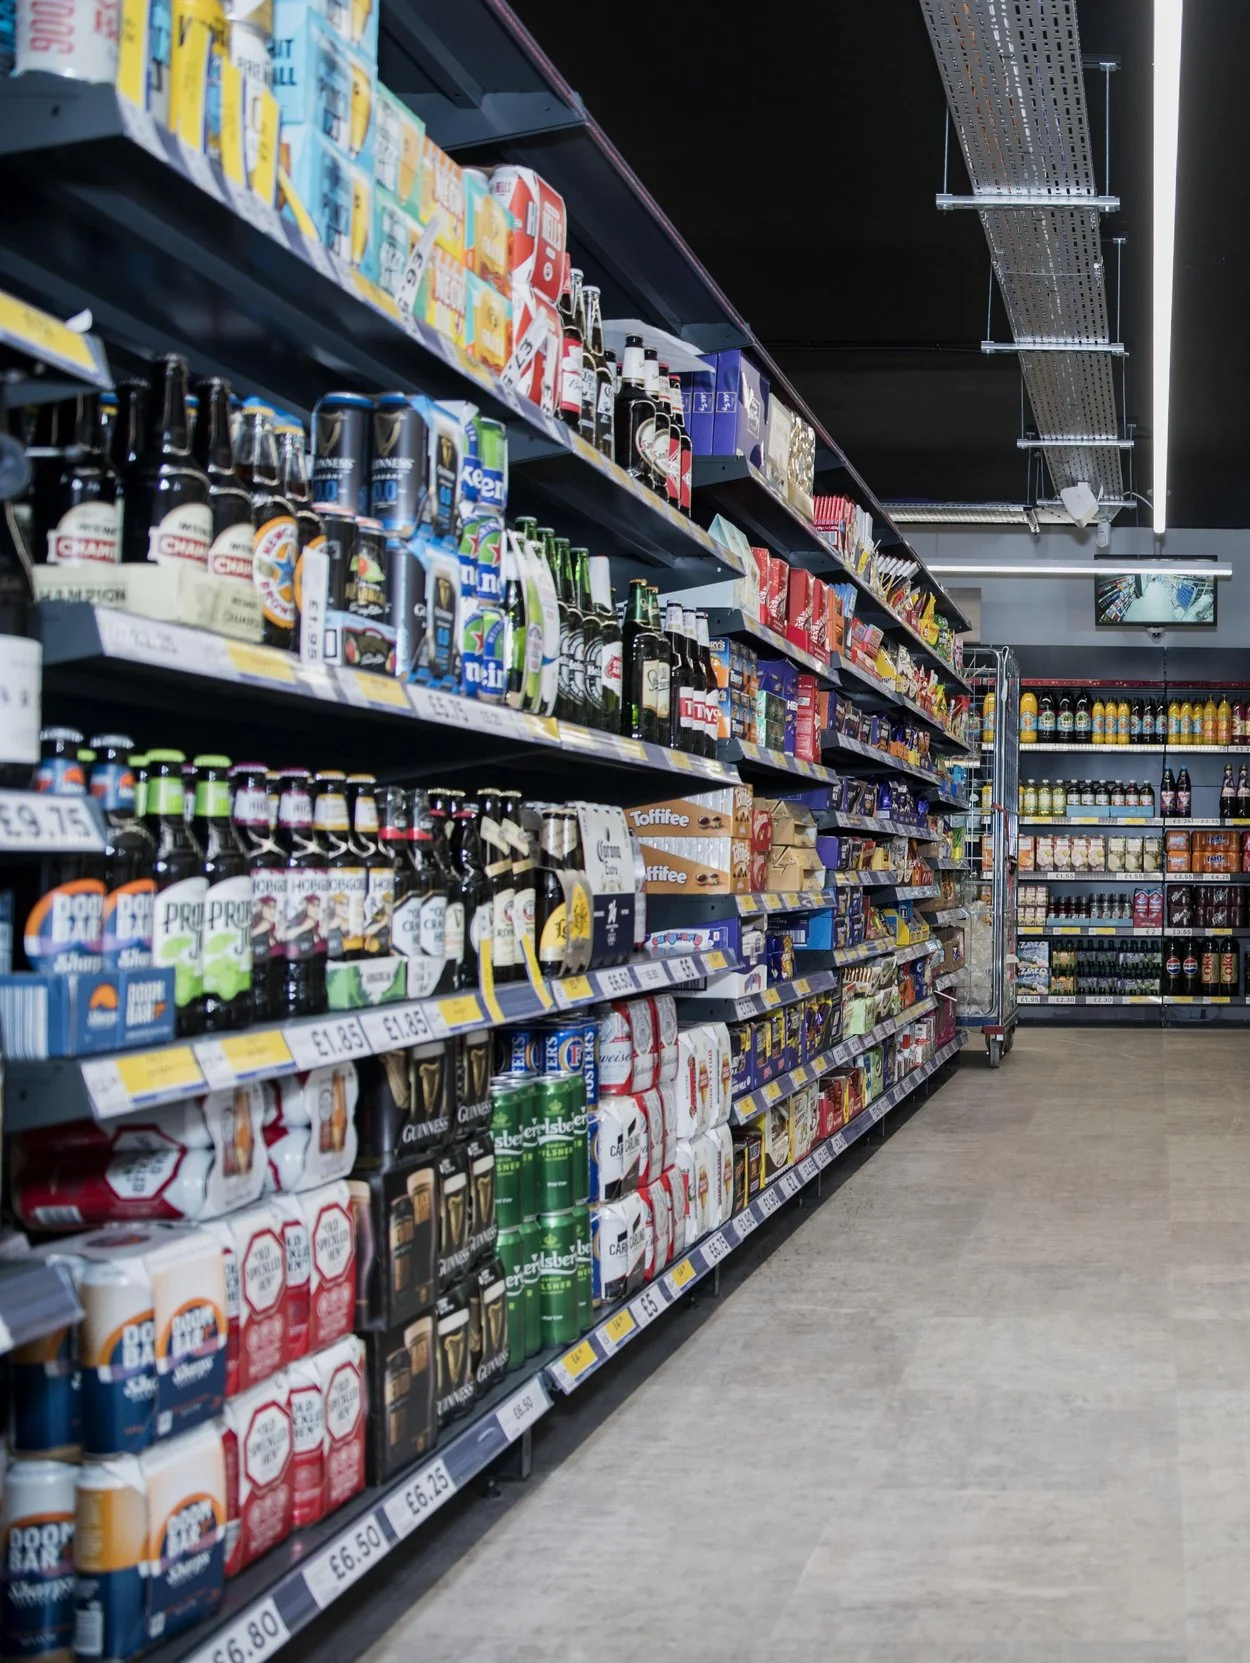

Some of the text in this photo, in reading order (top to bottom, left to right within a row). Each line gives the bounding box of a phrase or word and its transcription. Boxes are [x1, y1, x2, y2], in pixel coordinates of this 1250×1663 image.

[0, 803, 89, 838] £9.75
[628, 807, 691, 828] Toffifee
[645, 865, 688, 885] ffifee
[312, 1023, 364, 1057] £1.85
[384, 1009, 429, 1042] £1.85
[600, 1051, 632, 1064] weise
[402, 1116, 449, 1145] GUINNESS
[640, 1292, 658, 1318] £5
[513, 1395, 534, 1420] £6.50
[404, 1466, 451, 1516] £6.25
[328, 1524, 382, 1580] £6.50
[212, 1609, 280, 1663] £6.80
